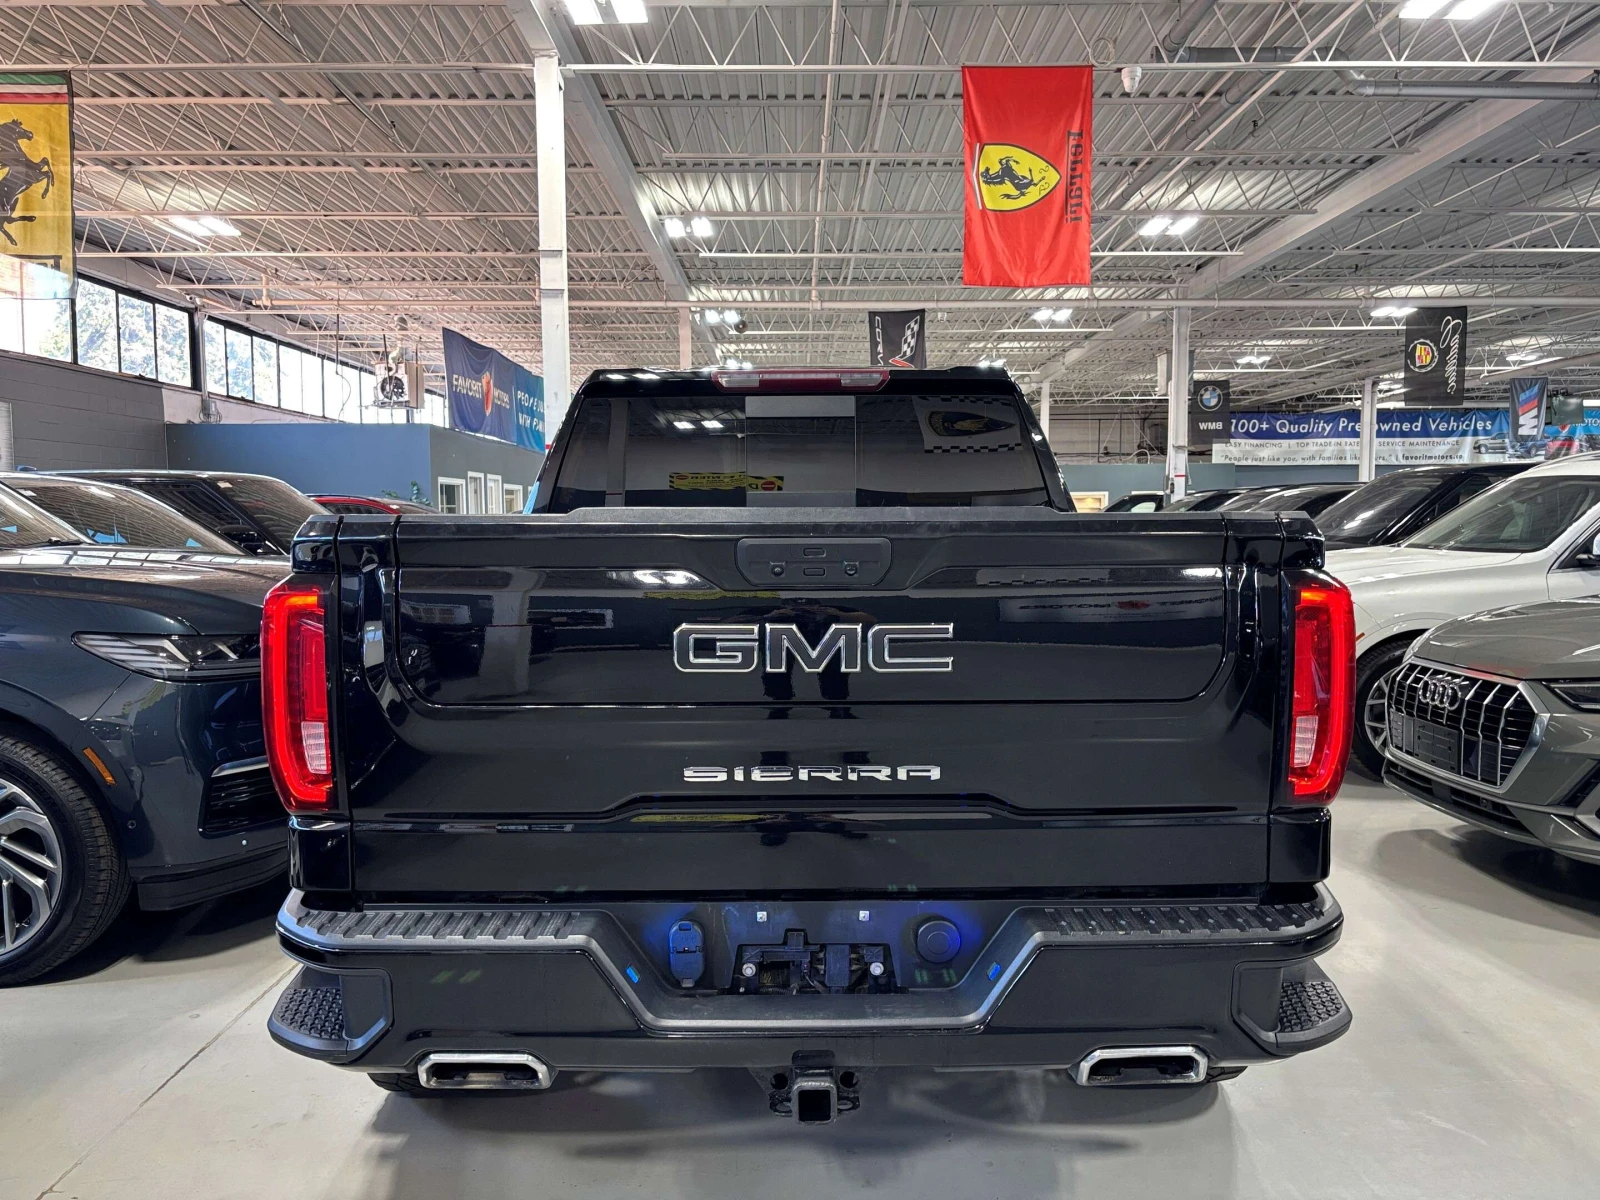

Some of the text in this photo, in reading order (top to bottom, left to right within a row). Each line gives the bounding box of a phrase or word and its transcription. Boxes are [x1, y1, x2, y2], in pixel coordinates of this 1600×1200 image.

[875, 315, 884, 366] CORV
[1276, 418, 1333, 436] Quality
[1428, 415, 1492, 432] Vehicles
[1251, 455, 1265, 464] just
[1318, 453, 1347, 461] families
[672, 622, 954, 673] GMC
[683, 765, 941, 782] SIERRA
